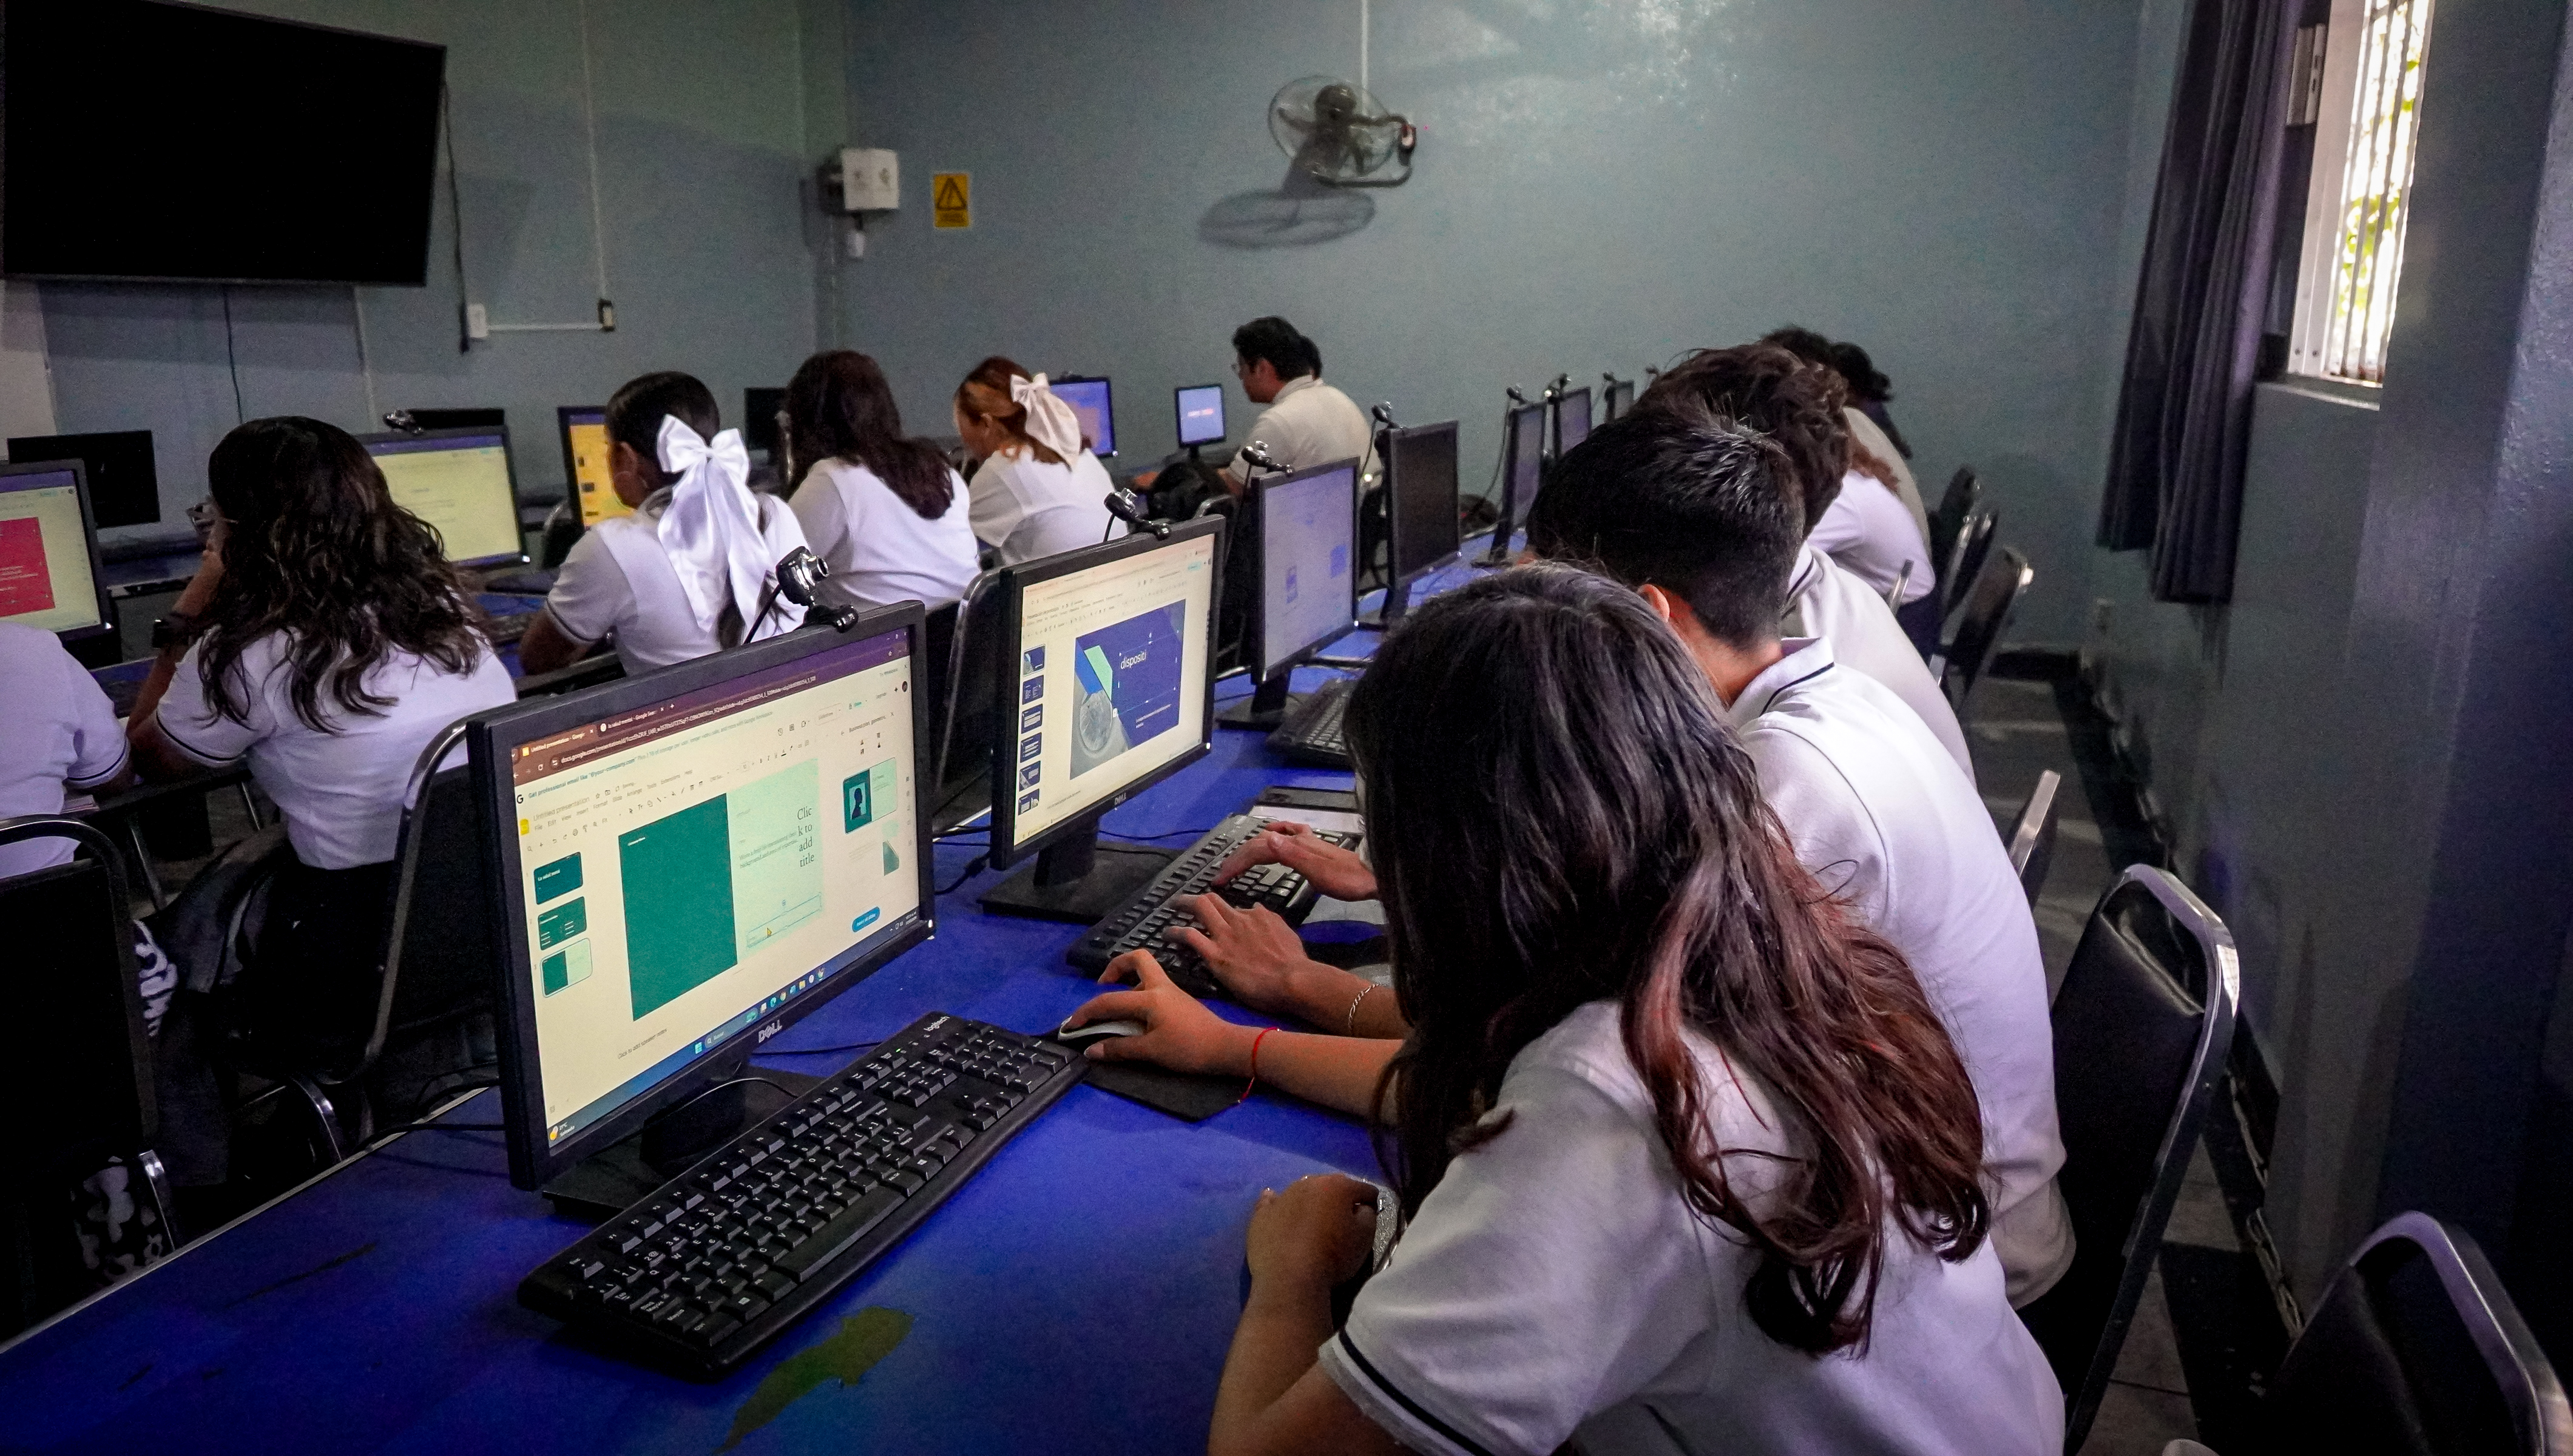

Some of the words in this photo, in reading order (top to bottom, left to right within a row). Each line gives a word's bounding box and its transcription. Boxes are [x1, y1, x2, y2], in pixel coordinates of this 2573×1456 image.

[1120, 649, 1146, 669] dispositi
[538, 781, 566, 797] professional
[567, 777, 579, 785] email
[533, 808, 555, 821] Untitled
[556, 796, 590, 814] presentation
[797, 806, 813, 820] Clic
[797, 826, 803, 837] k
[805, 824, 813, 834] to
[799, 836, 813, 852] add
[800, 853, 815, 868] title
[759, 1020, 782, 1043] DELL
[924, 1017, 950, 1031] logitech
